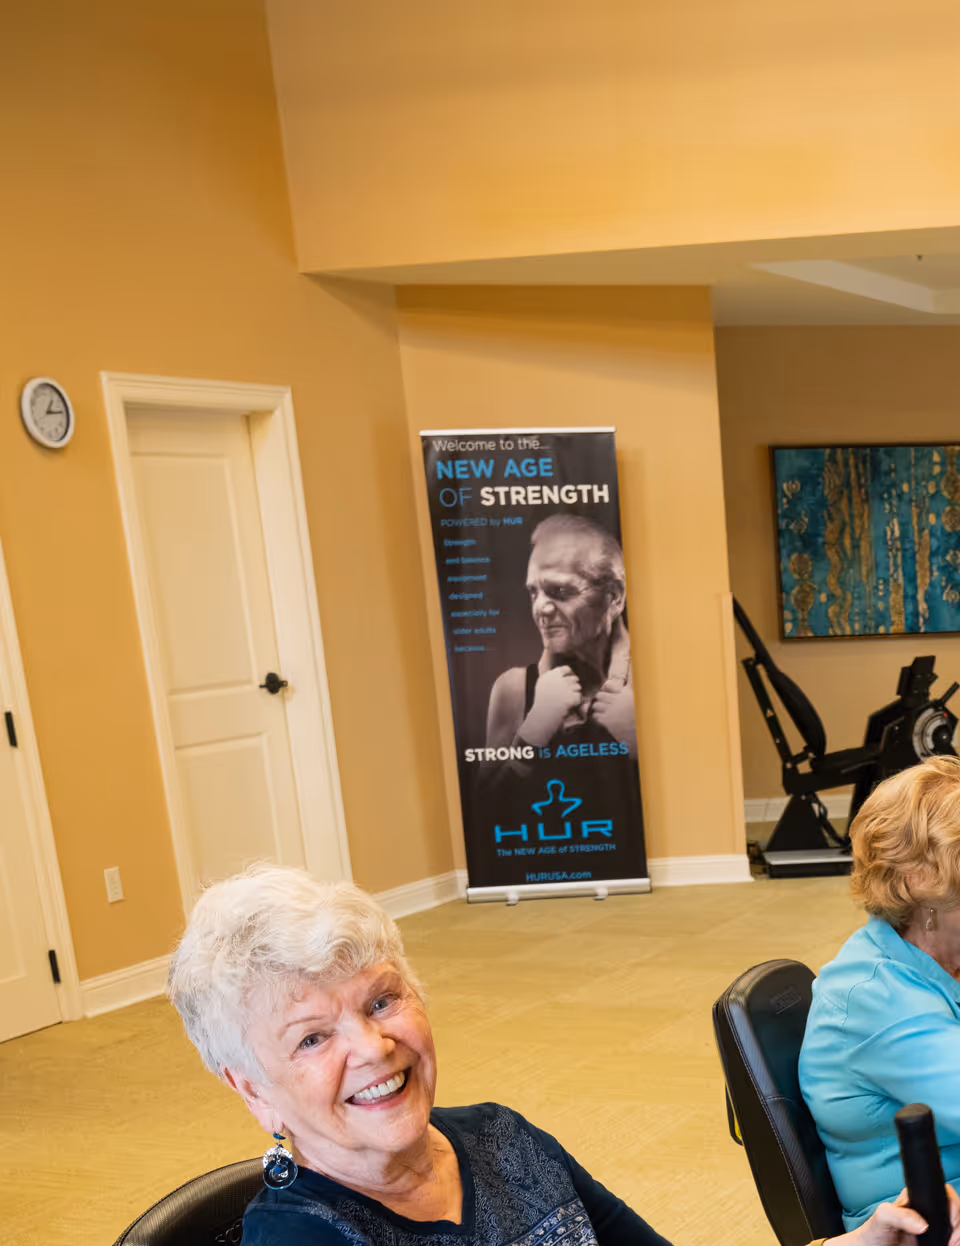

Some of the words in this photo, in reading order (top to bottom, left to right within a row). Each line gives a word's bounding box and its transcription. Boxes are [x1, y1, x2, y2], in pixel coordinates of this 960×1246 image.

[432, 438, 496, 452] Welcome
[499, 439, 514, 450] to
[436, 459, 495, 479] NEW
[504, 458, 553, 477] AGE
[439, 487, 472, 507] OF
[480, 484, 610, 506] STRENGTH
[503, 516, 523, 525] HUR
[464, 746, 534, 762] STRONG
[555, 742, 629, 758] AGELESS
[494, 819, 613, 843] HUR
[514, 847, 536, 855] NEW
[538, 846, 557, 854] AGE
[569, 843, 616, 853] STRENGTH
[526, 871, 592, 881] HURUSA.com
